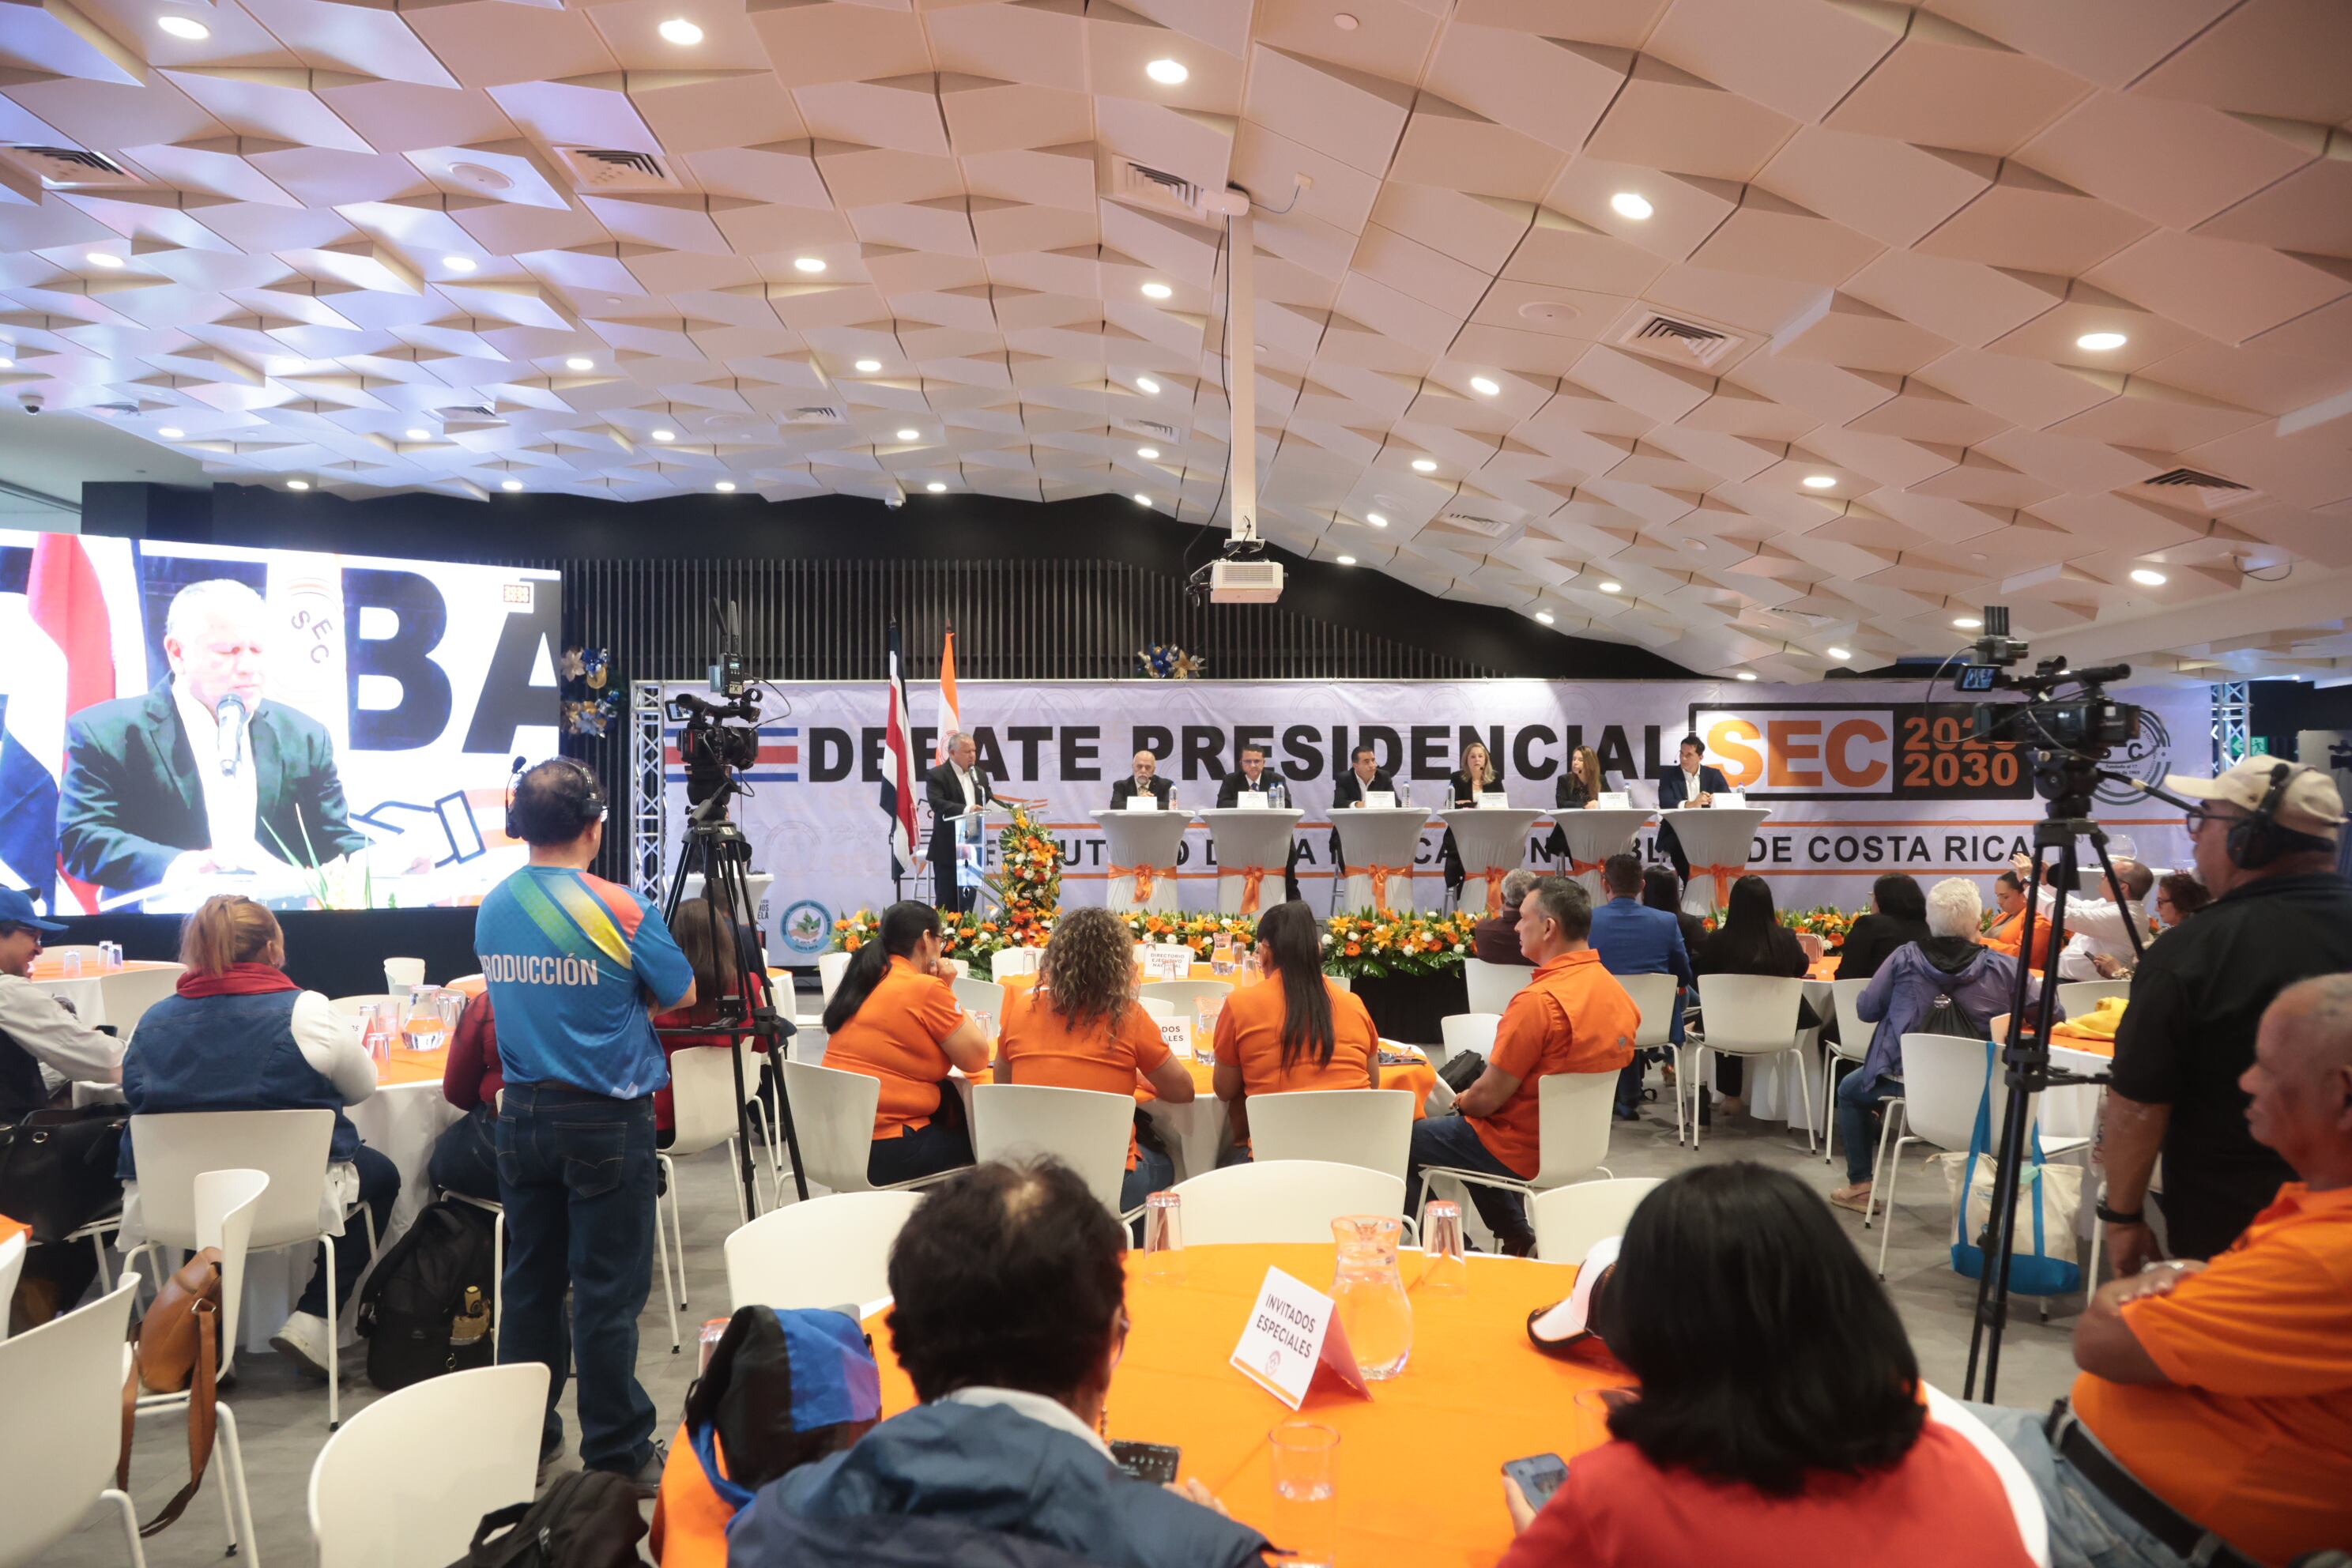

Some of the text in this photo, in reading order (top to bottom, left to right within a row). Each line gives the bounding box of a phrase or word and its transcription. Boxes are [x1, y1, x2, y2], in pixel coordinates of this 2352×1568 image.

[1706, 718, 1889, 789] SEC
[1902, 752, 2019, 787] 2030
[1747, 836, 1792, 863] DE
[1807, 835, 1932, 863] COSTA
[1944, 835, 2032, 863] RICA
[1265, 1293, 1316, 1334] INVITADOS
[1257, 1314, 1313, 1359] ESPECIALES
